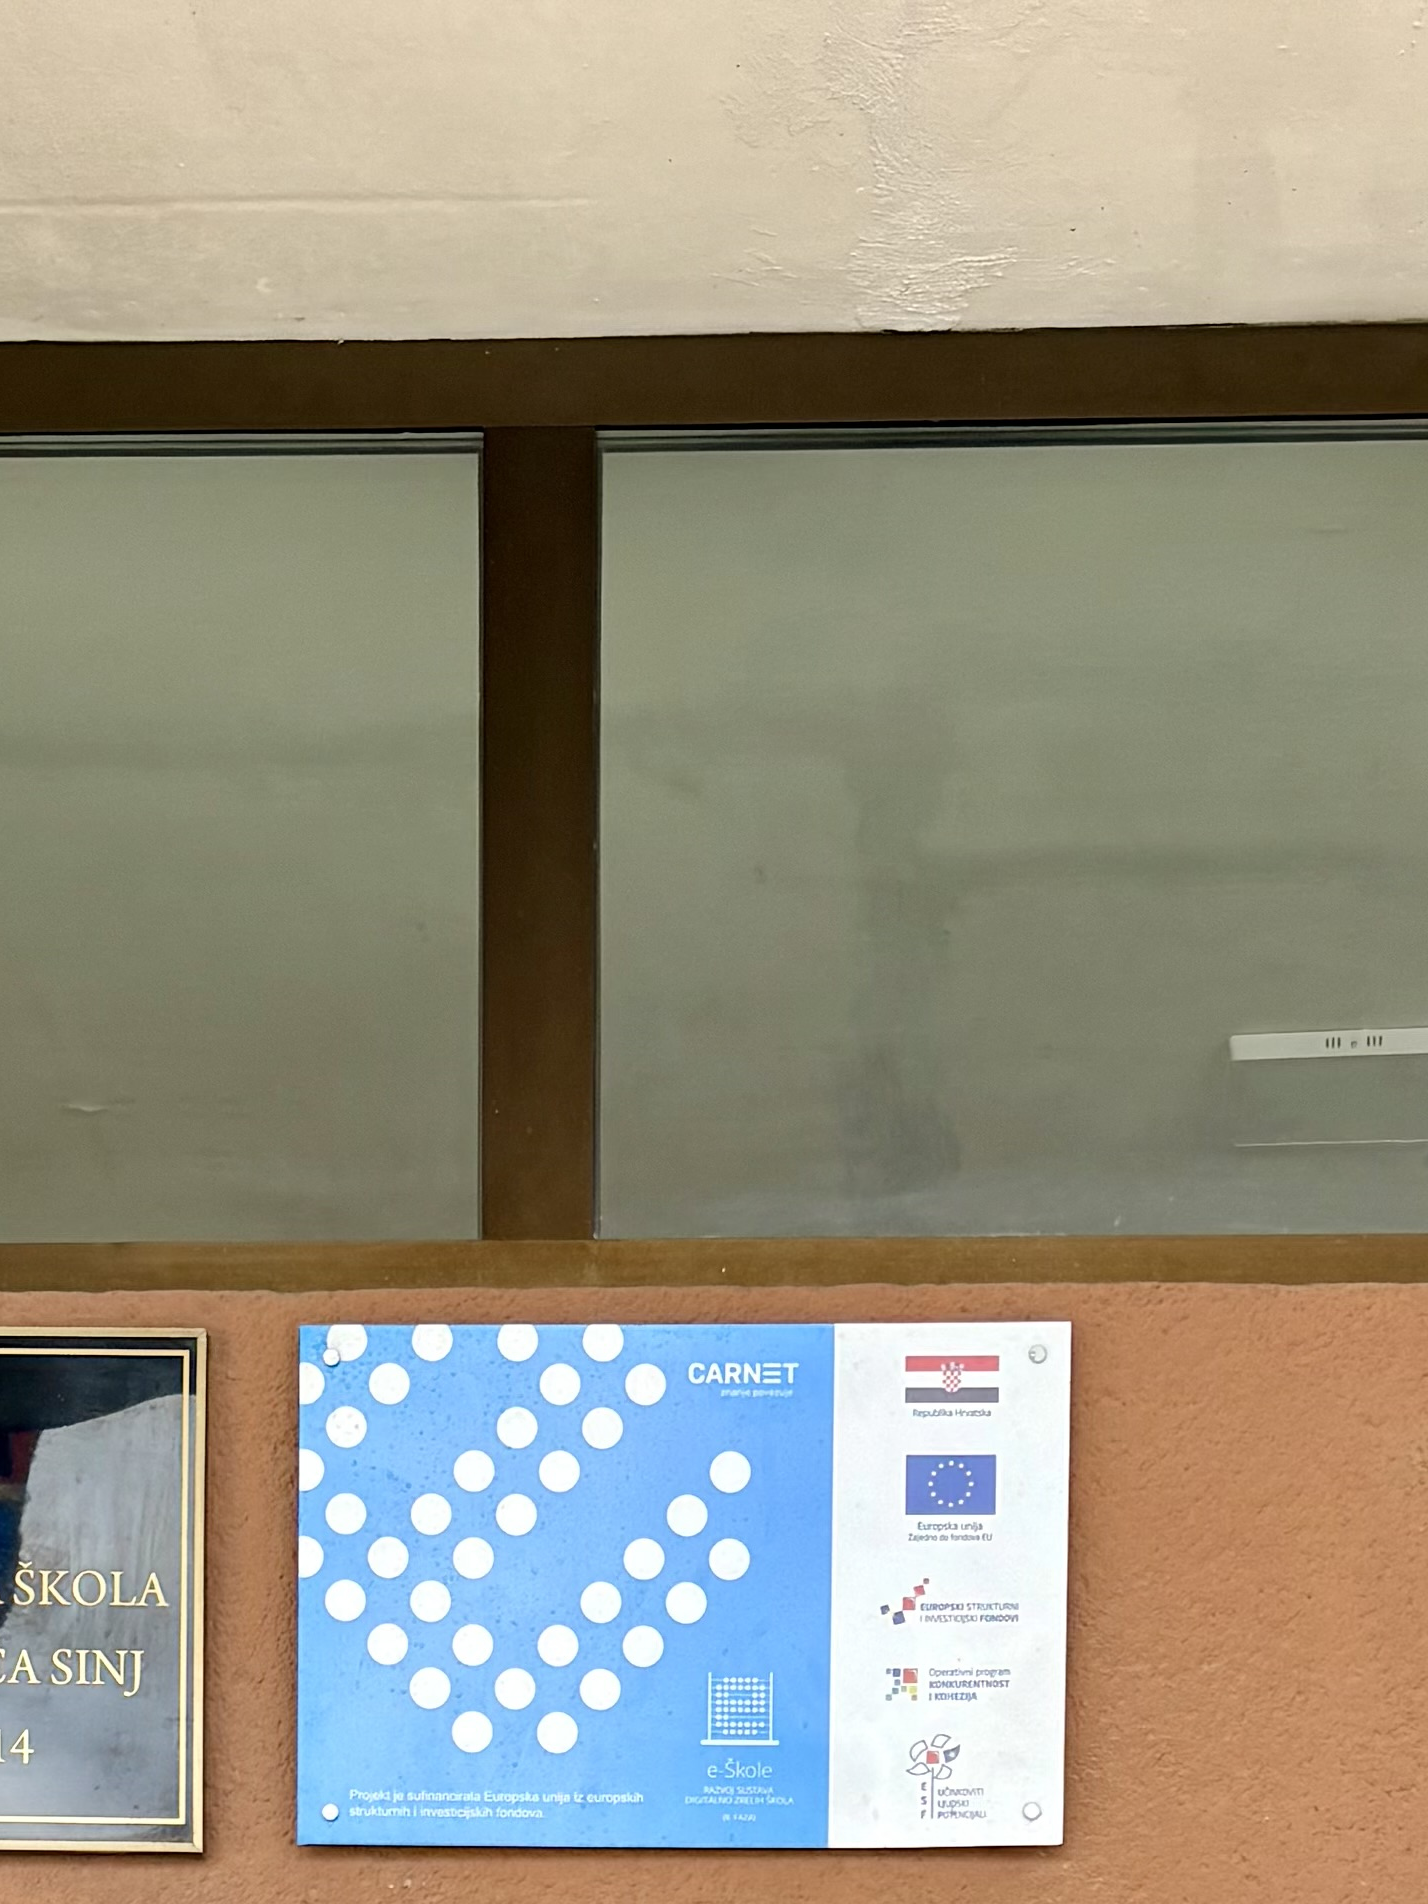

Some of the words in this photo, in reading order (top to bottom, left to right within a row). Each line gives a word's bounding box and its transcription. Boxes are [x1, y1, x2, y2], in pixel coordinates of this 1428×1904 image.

[688, 1362, 800, 1385] CARNET
[917, 1521, 958, 1532] Europska
[960, 1521, 983, 1532] unija
[12, 1560, 170, 1608] ŠKOLA
[50, 1648, 145, 1697] SINJ
[929, 1668, 974, 1677] Operativni
[975, 1668, 1011, 1679] program
[929, 1679, 1011, 1689] KONKURENTNOST
[934, 1692, 978, 1702] KOHEZIJA
[707, 1758, 773, 1779] e-Škole
[349, 1788, 390, 1802] Projekt
[392, 1790, 404, 1803] je
[407, 1790, 481, 1802] sufinancirala
[483, 1790, 539, 1805] Europska
[542, 1791, 570, 1805] unija
[573, 1791, 585, 1803] iz
[586, 1791, 644, 1806] europskih
[349, 1805, 411, 1818] strukturnih
[413, 1806, 417, 1817] i
[420, 1806, 493, 1820] investicijskih
